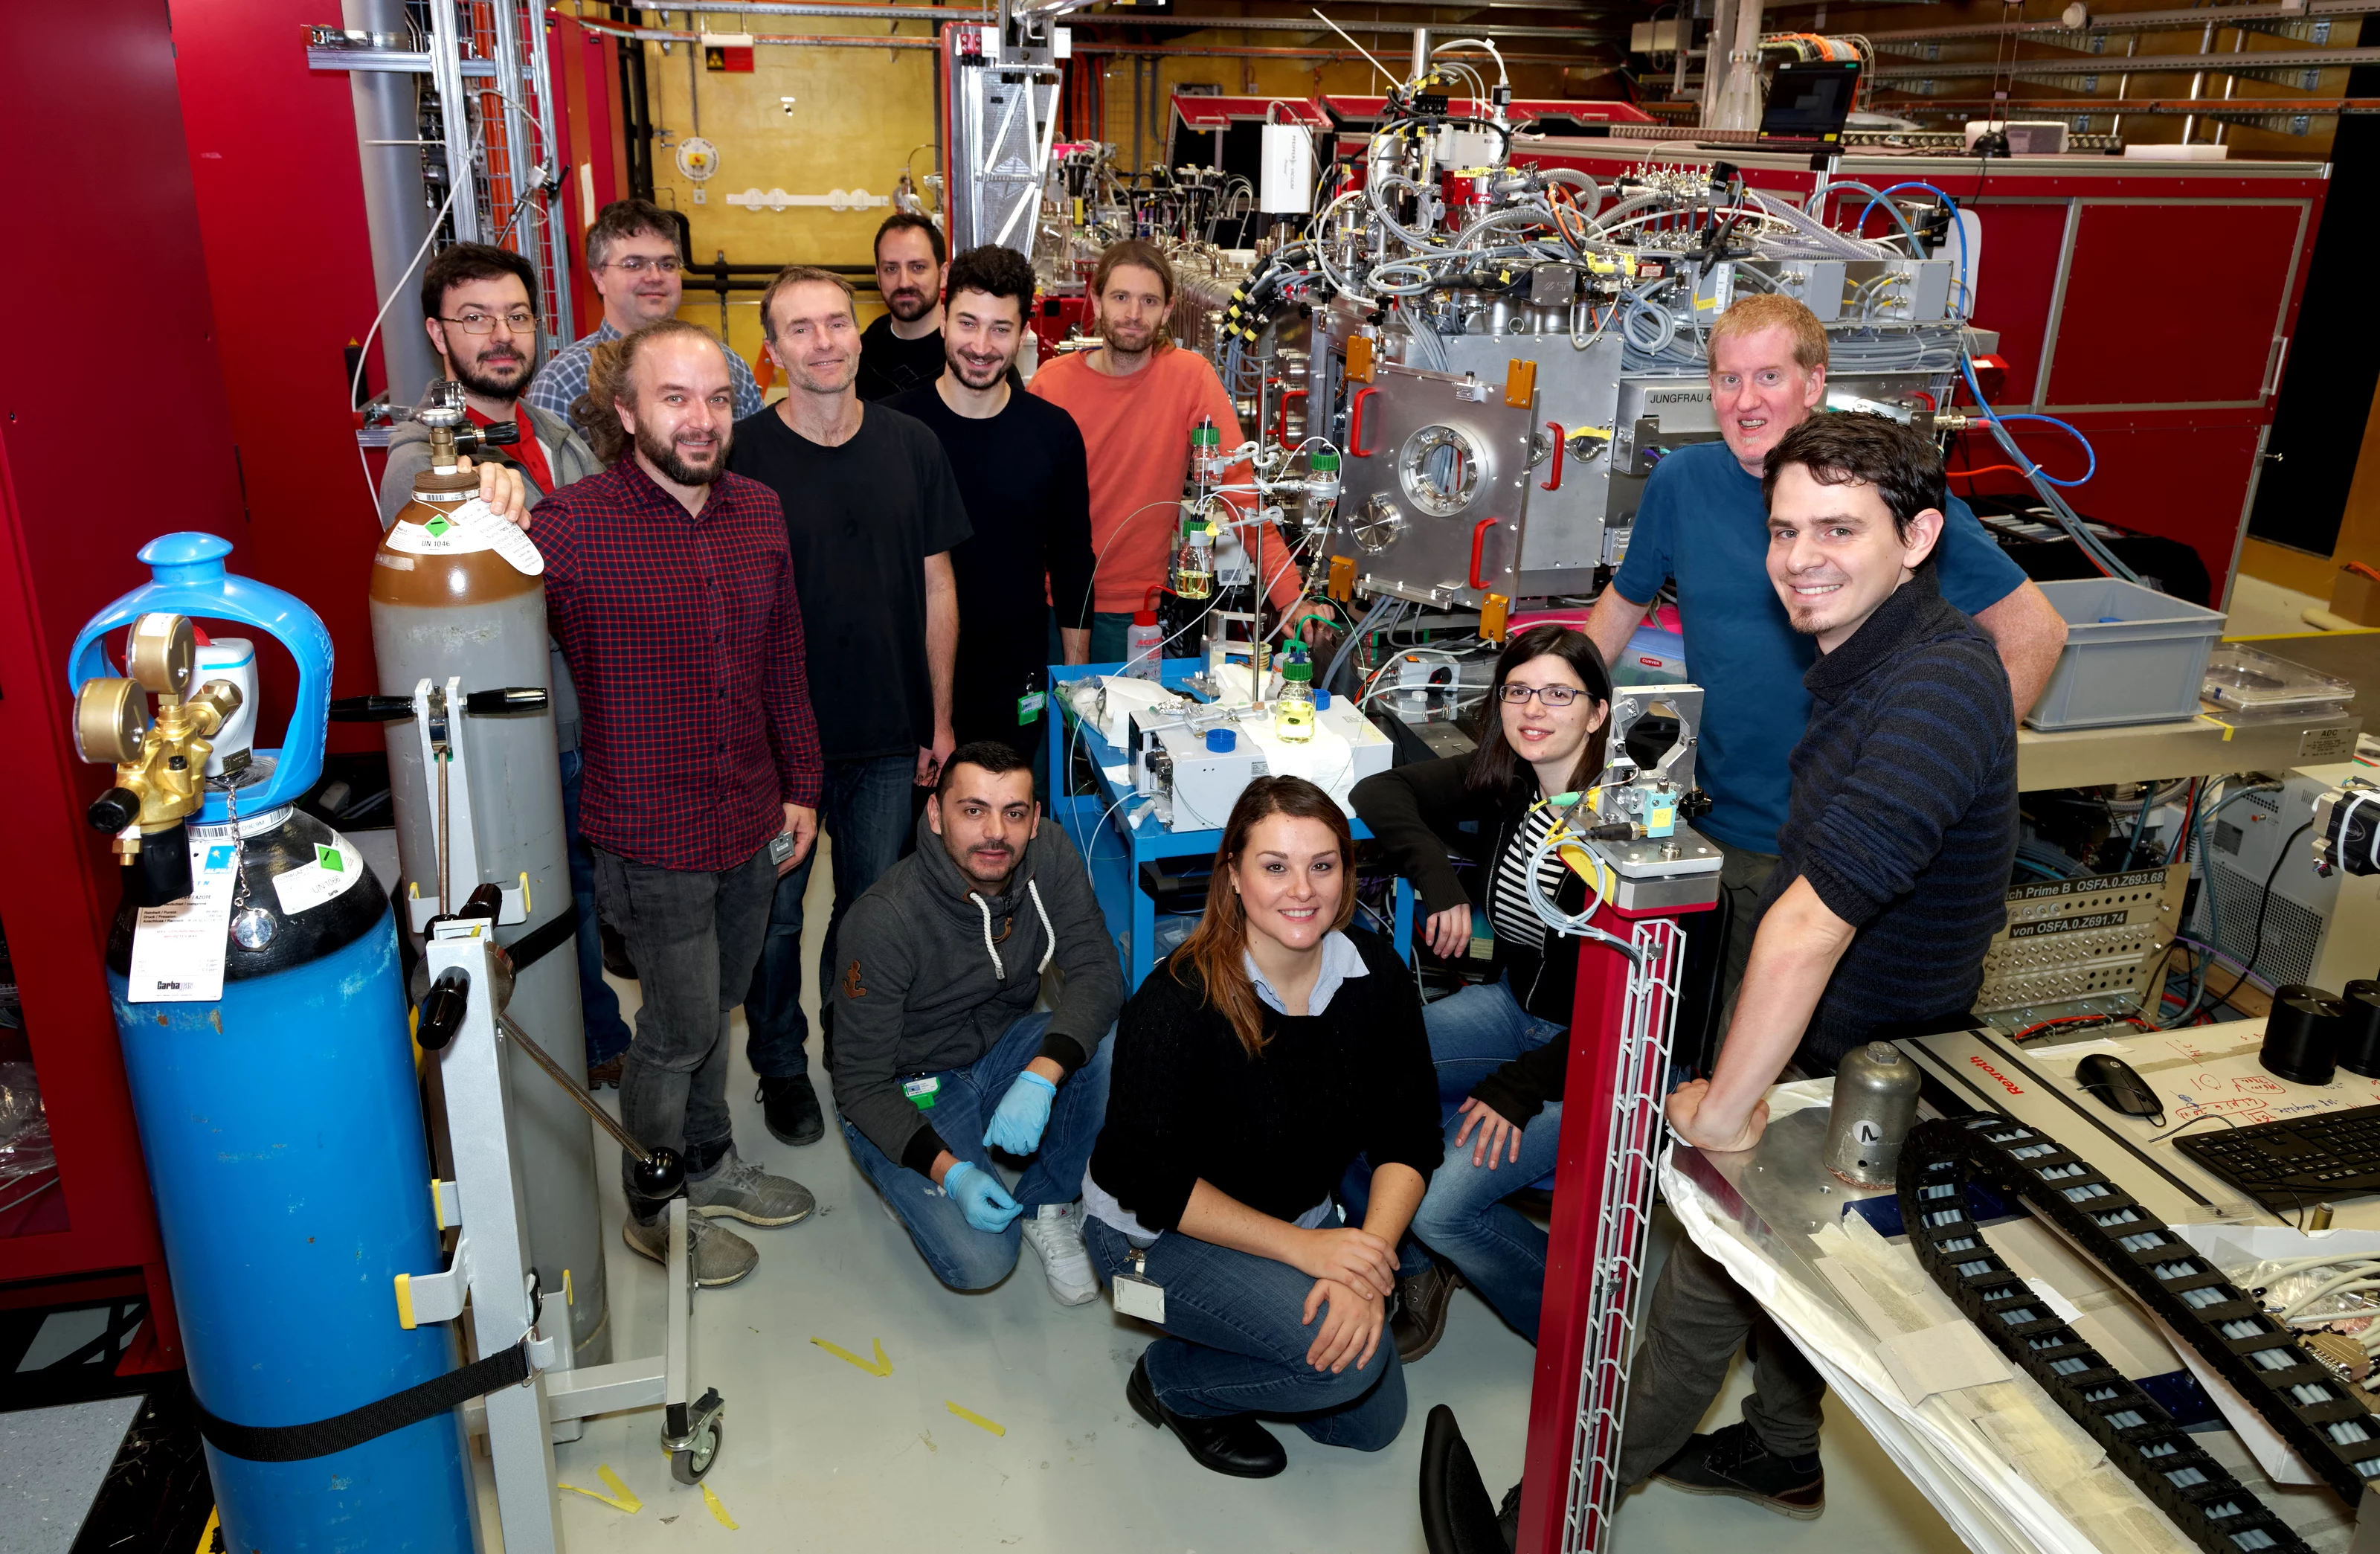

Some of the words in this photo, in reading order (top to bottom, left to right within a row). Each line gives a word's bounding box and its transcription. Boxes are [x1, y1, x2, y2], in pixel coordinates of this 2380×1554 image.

[1650, 394, 1704, 403] JUNGFRAU
[2026, 885, 2059, 899] Prime
[2062, 883, 2071, 893] B
[2077, 871, 2164, 892] OSFA.0.Z693.68
[2013, 925, 2034, 937] von
[2037, 913, 2124, 933] OSFA.0.Z691.74
[1969, 1056, 2024, 1095] Rexroth
